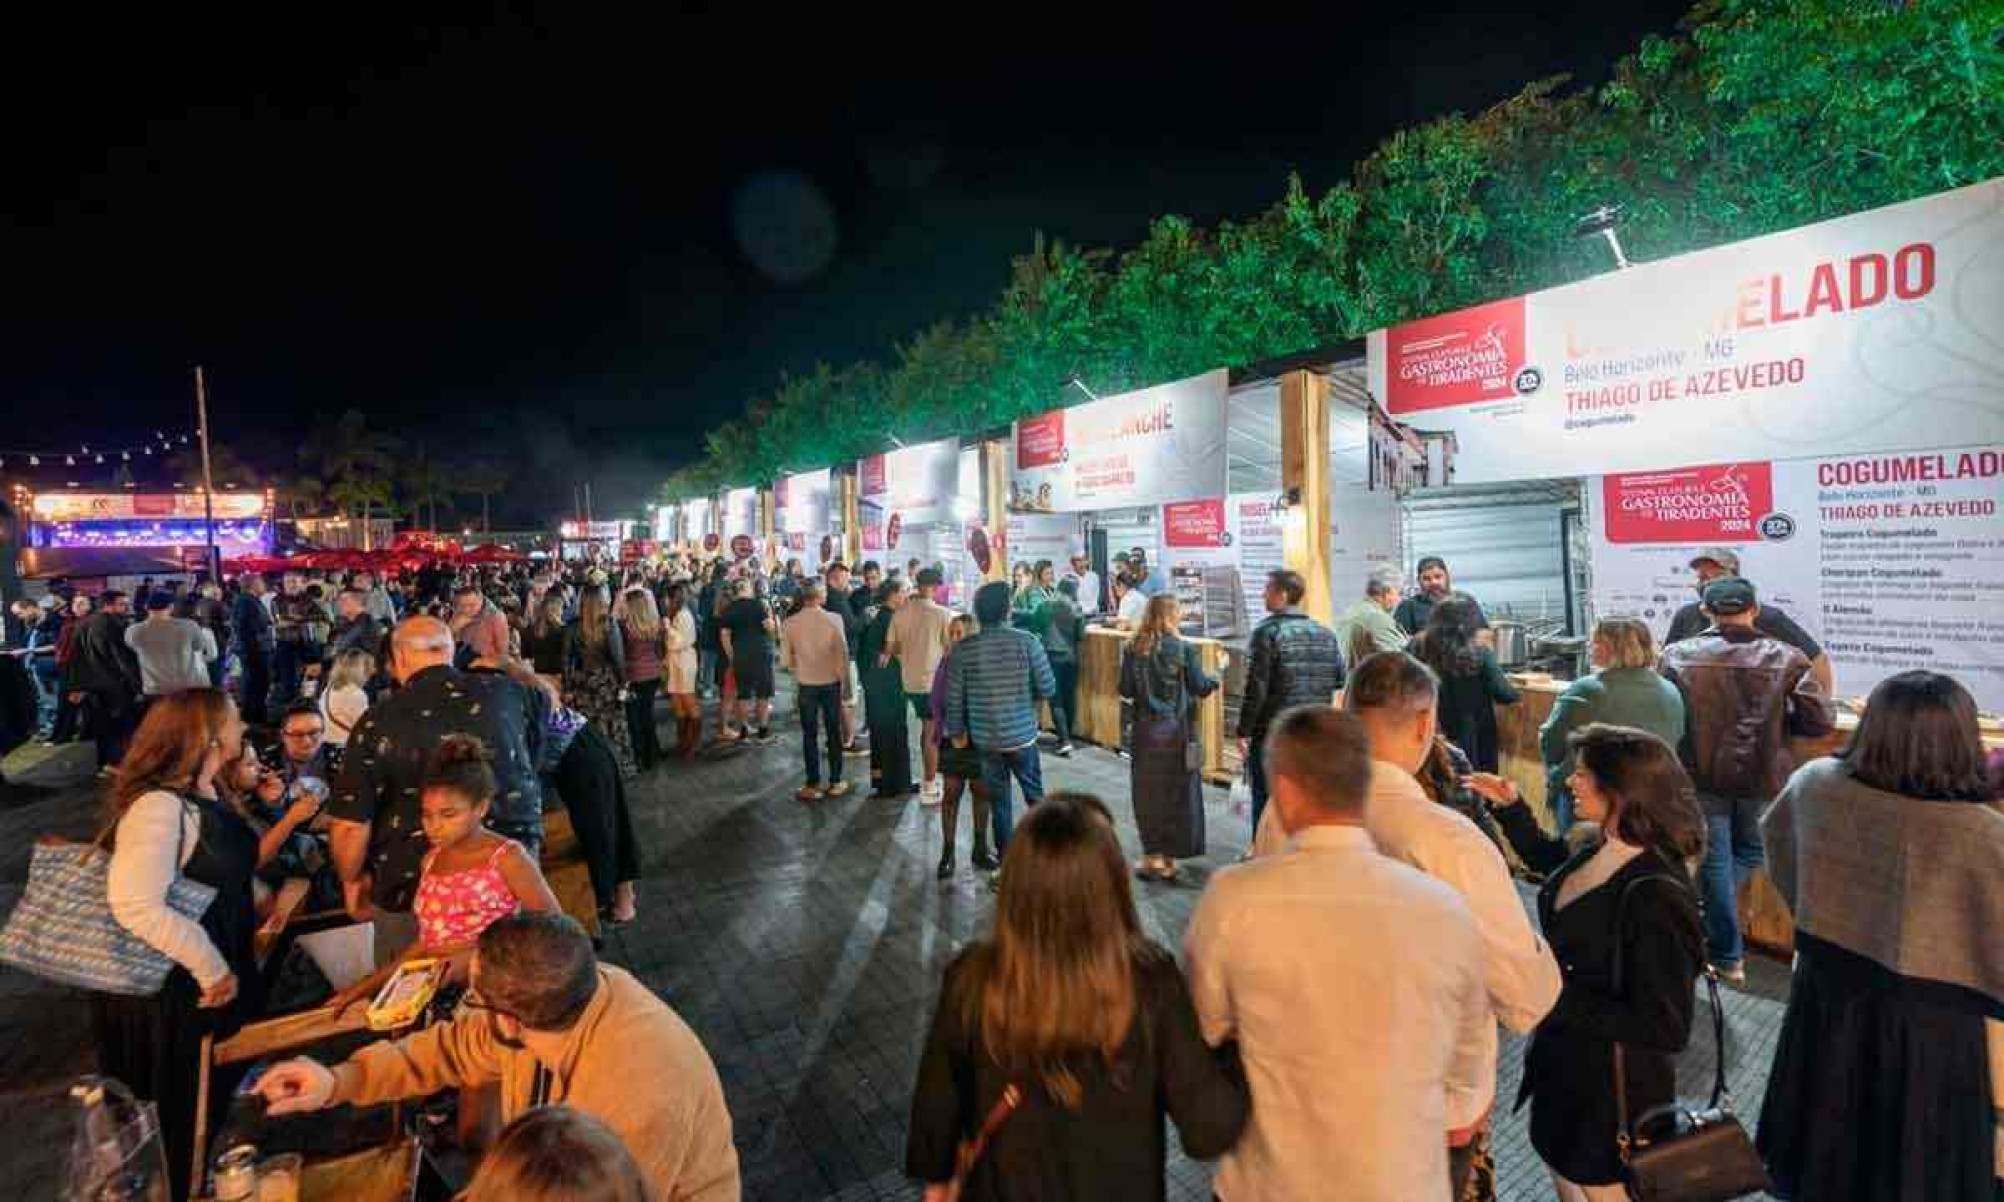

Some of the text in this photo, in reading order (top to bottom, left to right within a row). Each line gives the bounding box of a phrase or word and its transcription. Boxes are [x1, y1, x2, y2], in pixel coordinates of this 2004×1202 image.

[1704, 338, 1734, 360] MG
[1401, 350, 1506, 379] GASTRONOMIA
[1566, 358, 1805, 414] THIAGO DE AZEVEDO
[1818, 451, 2004, 486] COGUMELAD
[1622, 493, 1750, 510] GASTRONOMIA
[1820, 499, 1996, 520] THIAGO DE AZEVEDO
[1656, 506, 1751, 520] TIRADENTES
[1720, 520, 1751, 531] 2024
